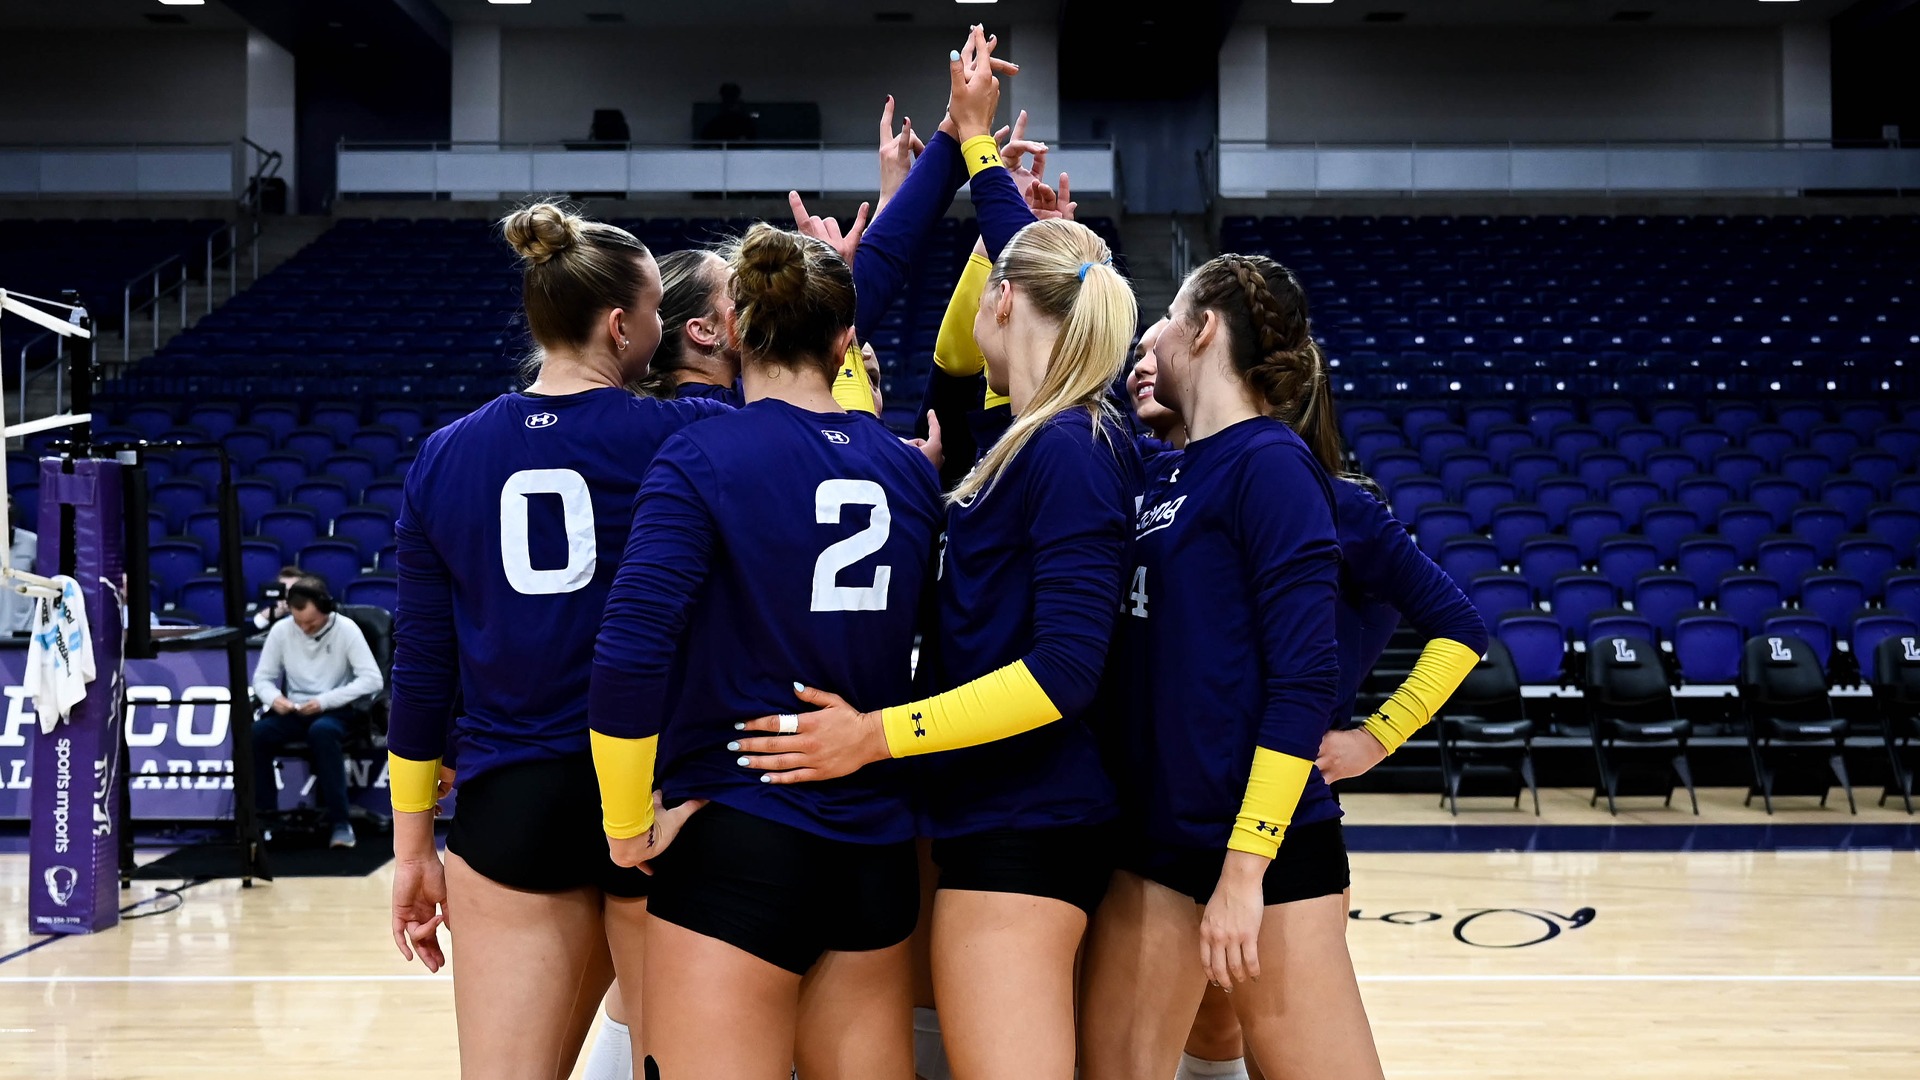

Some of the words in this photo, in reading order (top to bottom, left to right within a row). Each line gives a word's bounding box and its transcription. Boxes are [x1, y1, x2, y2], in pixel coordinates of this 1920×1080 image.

[500, 468, 597, 595] 0
[810, 478, 892, 613] 2
[1612, 638, 1637, 662] L
[1767, 637, 1792, 661] L
[1900, 637, 1920, 661] L
[54, 738, 72, 789] sports
[53, 790, 71, 853] imports
